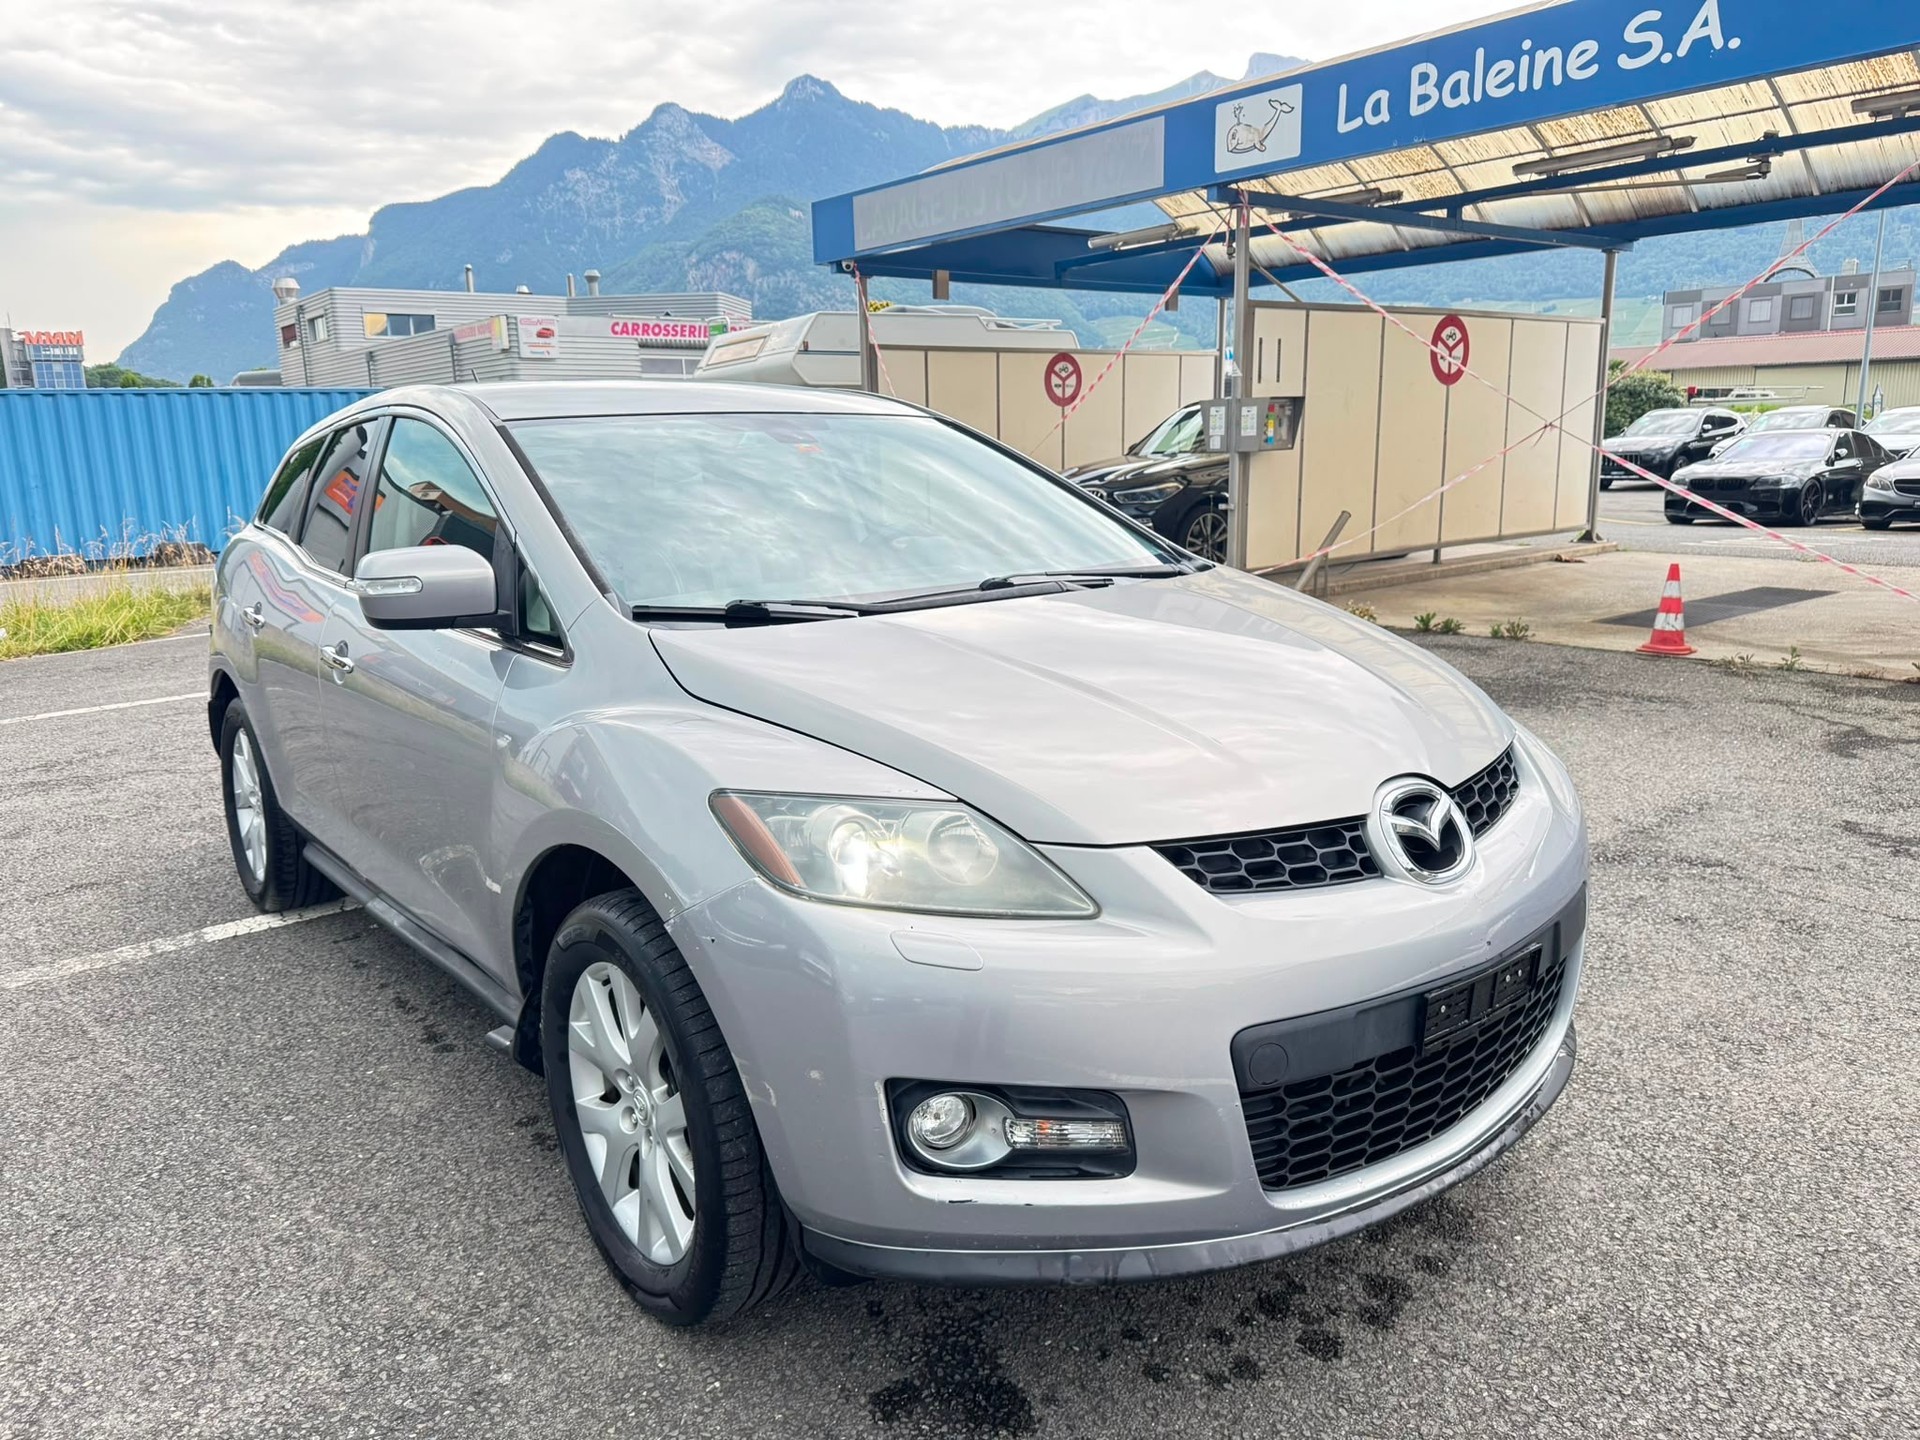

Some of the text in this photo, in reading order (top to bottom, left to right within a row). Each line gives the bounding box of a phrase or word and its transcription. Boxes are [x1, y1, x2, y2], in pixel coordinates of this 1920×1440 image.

[1337, 0, 1741, 133] La Baleine S.A.
[859, 193, 943, 241] LAVAGE
[24, 330, 84, 346] MMM
